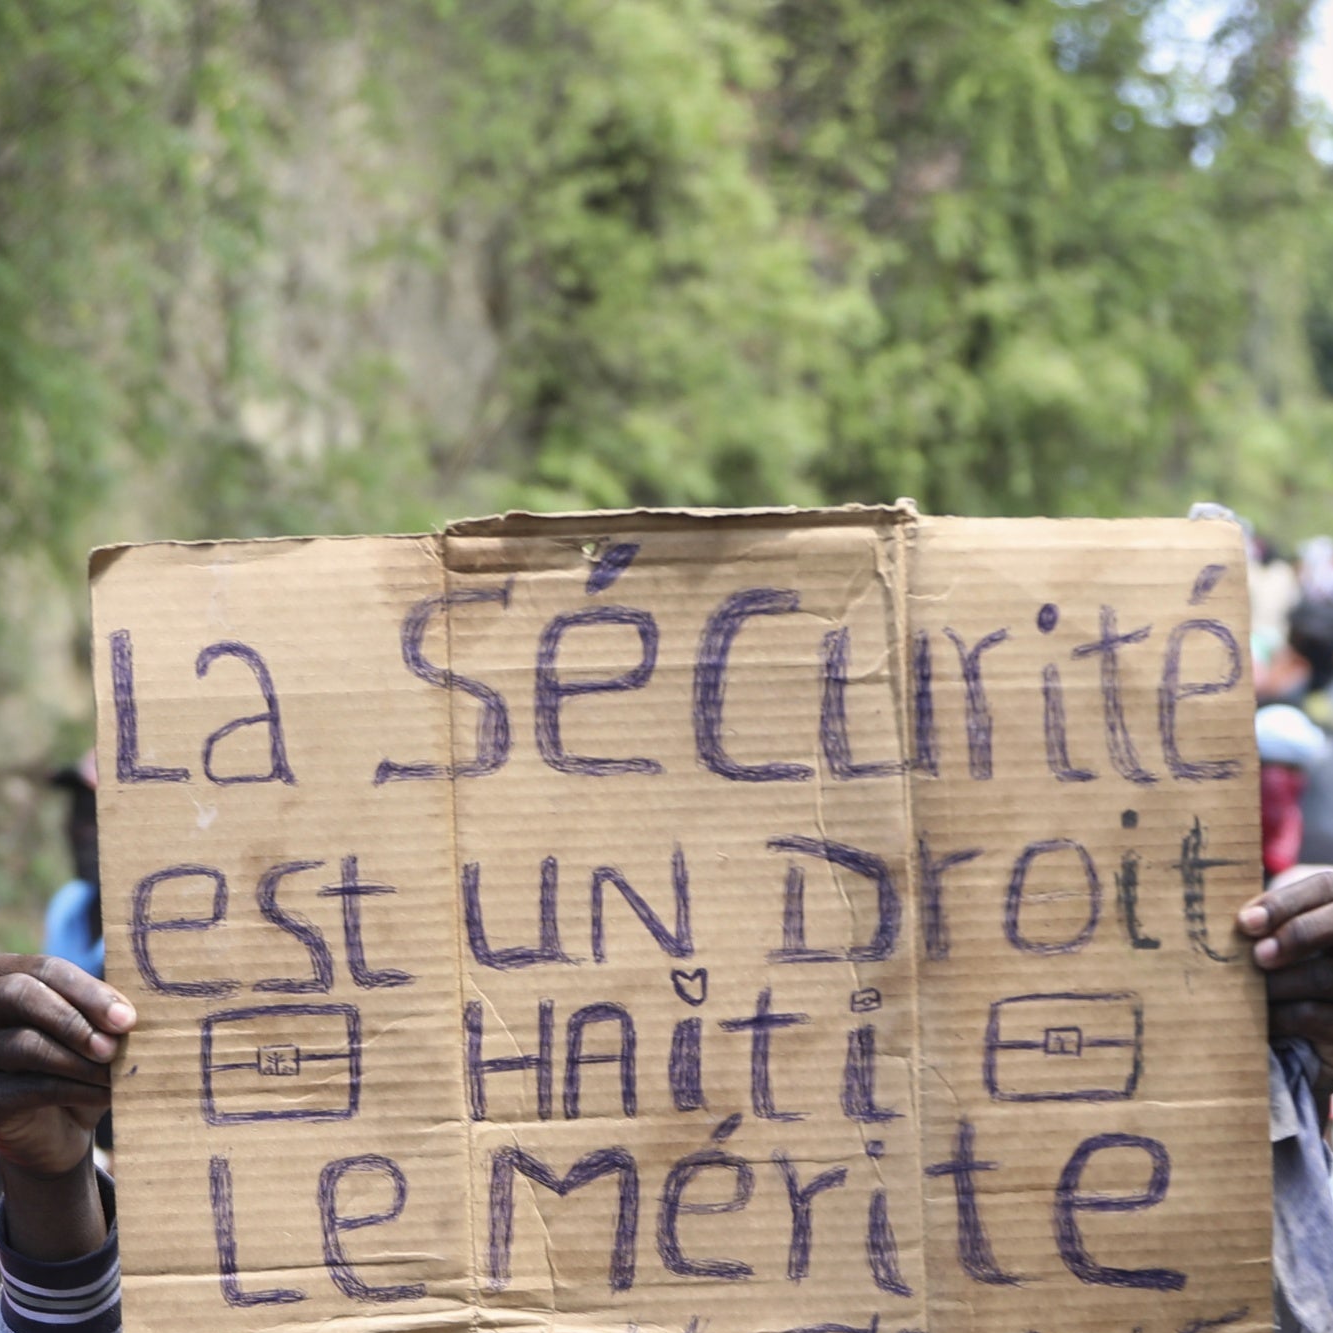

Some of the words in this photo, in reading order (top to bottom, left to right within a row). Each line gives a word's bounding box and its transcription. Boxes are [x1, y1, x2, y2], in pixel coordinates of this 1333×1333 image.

[109, 628, 297, 787] La
[131, 852, 418, 1000] est
[764, 807, 1249, 963] Droit
[210, 1153, 427, 1308] Le
